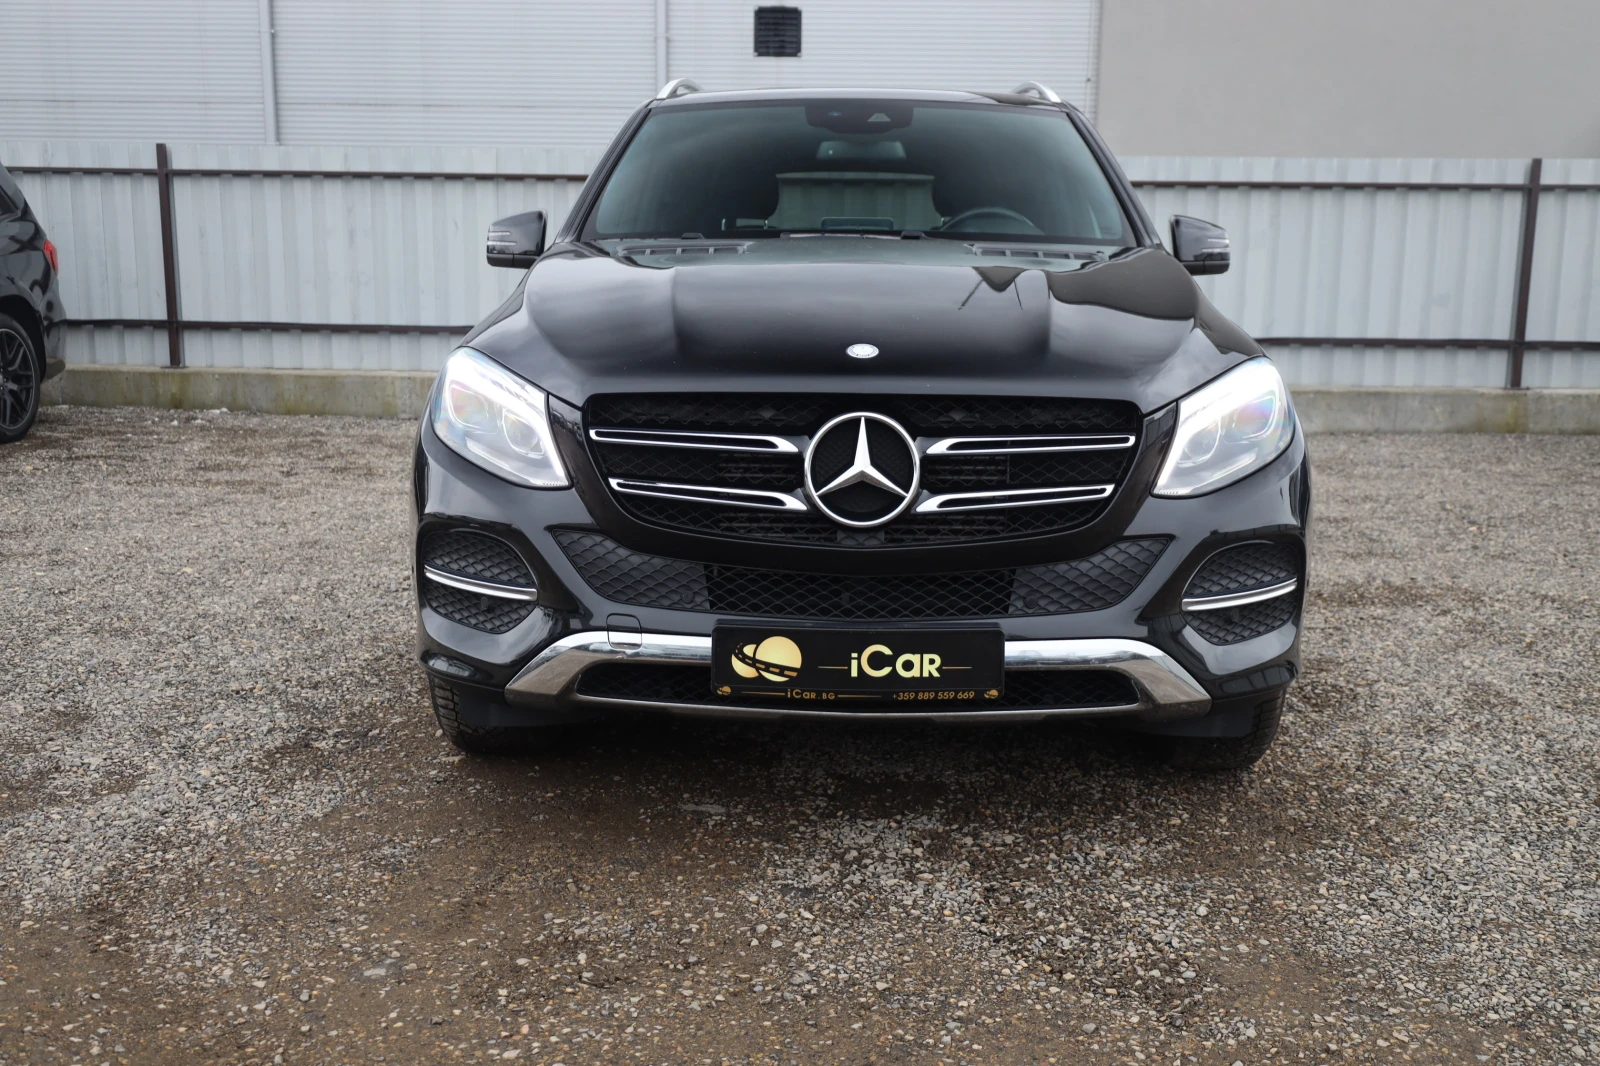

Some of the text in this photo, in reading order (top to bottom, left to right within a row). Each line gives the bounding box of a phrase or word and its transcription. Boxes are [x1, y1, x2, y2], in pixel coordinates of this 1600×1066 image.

[892, 690, 975, 700] +359 889 559 669
